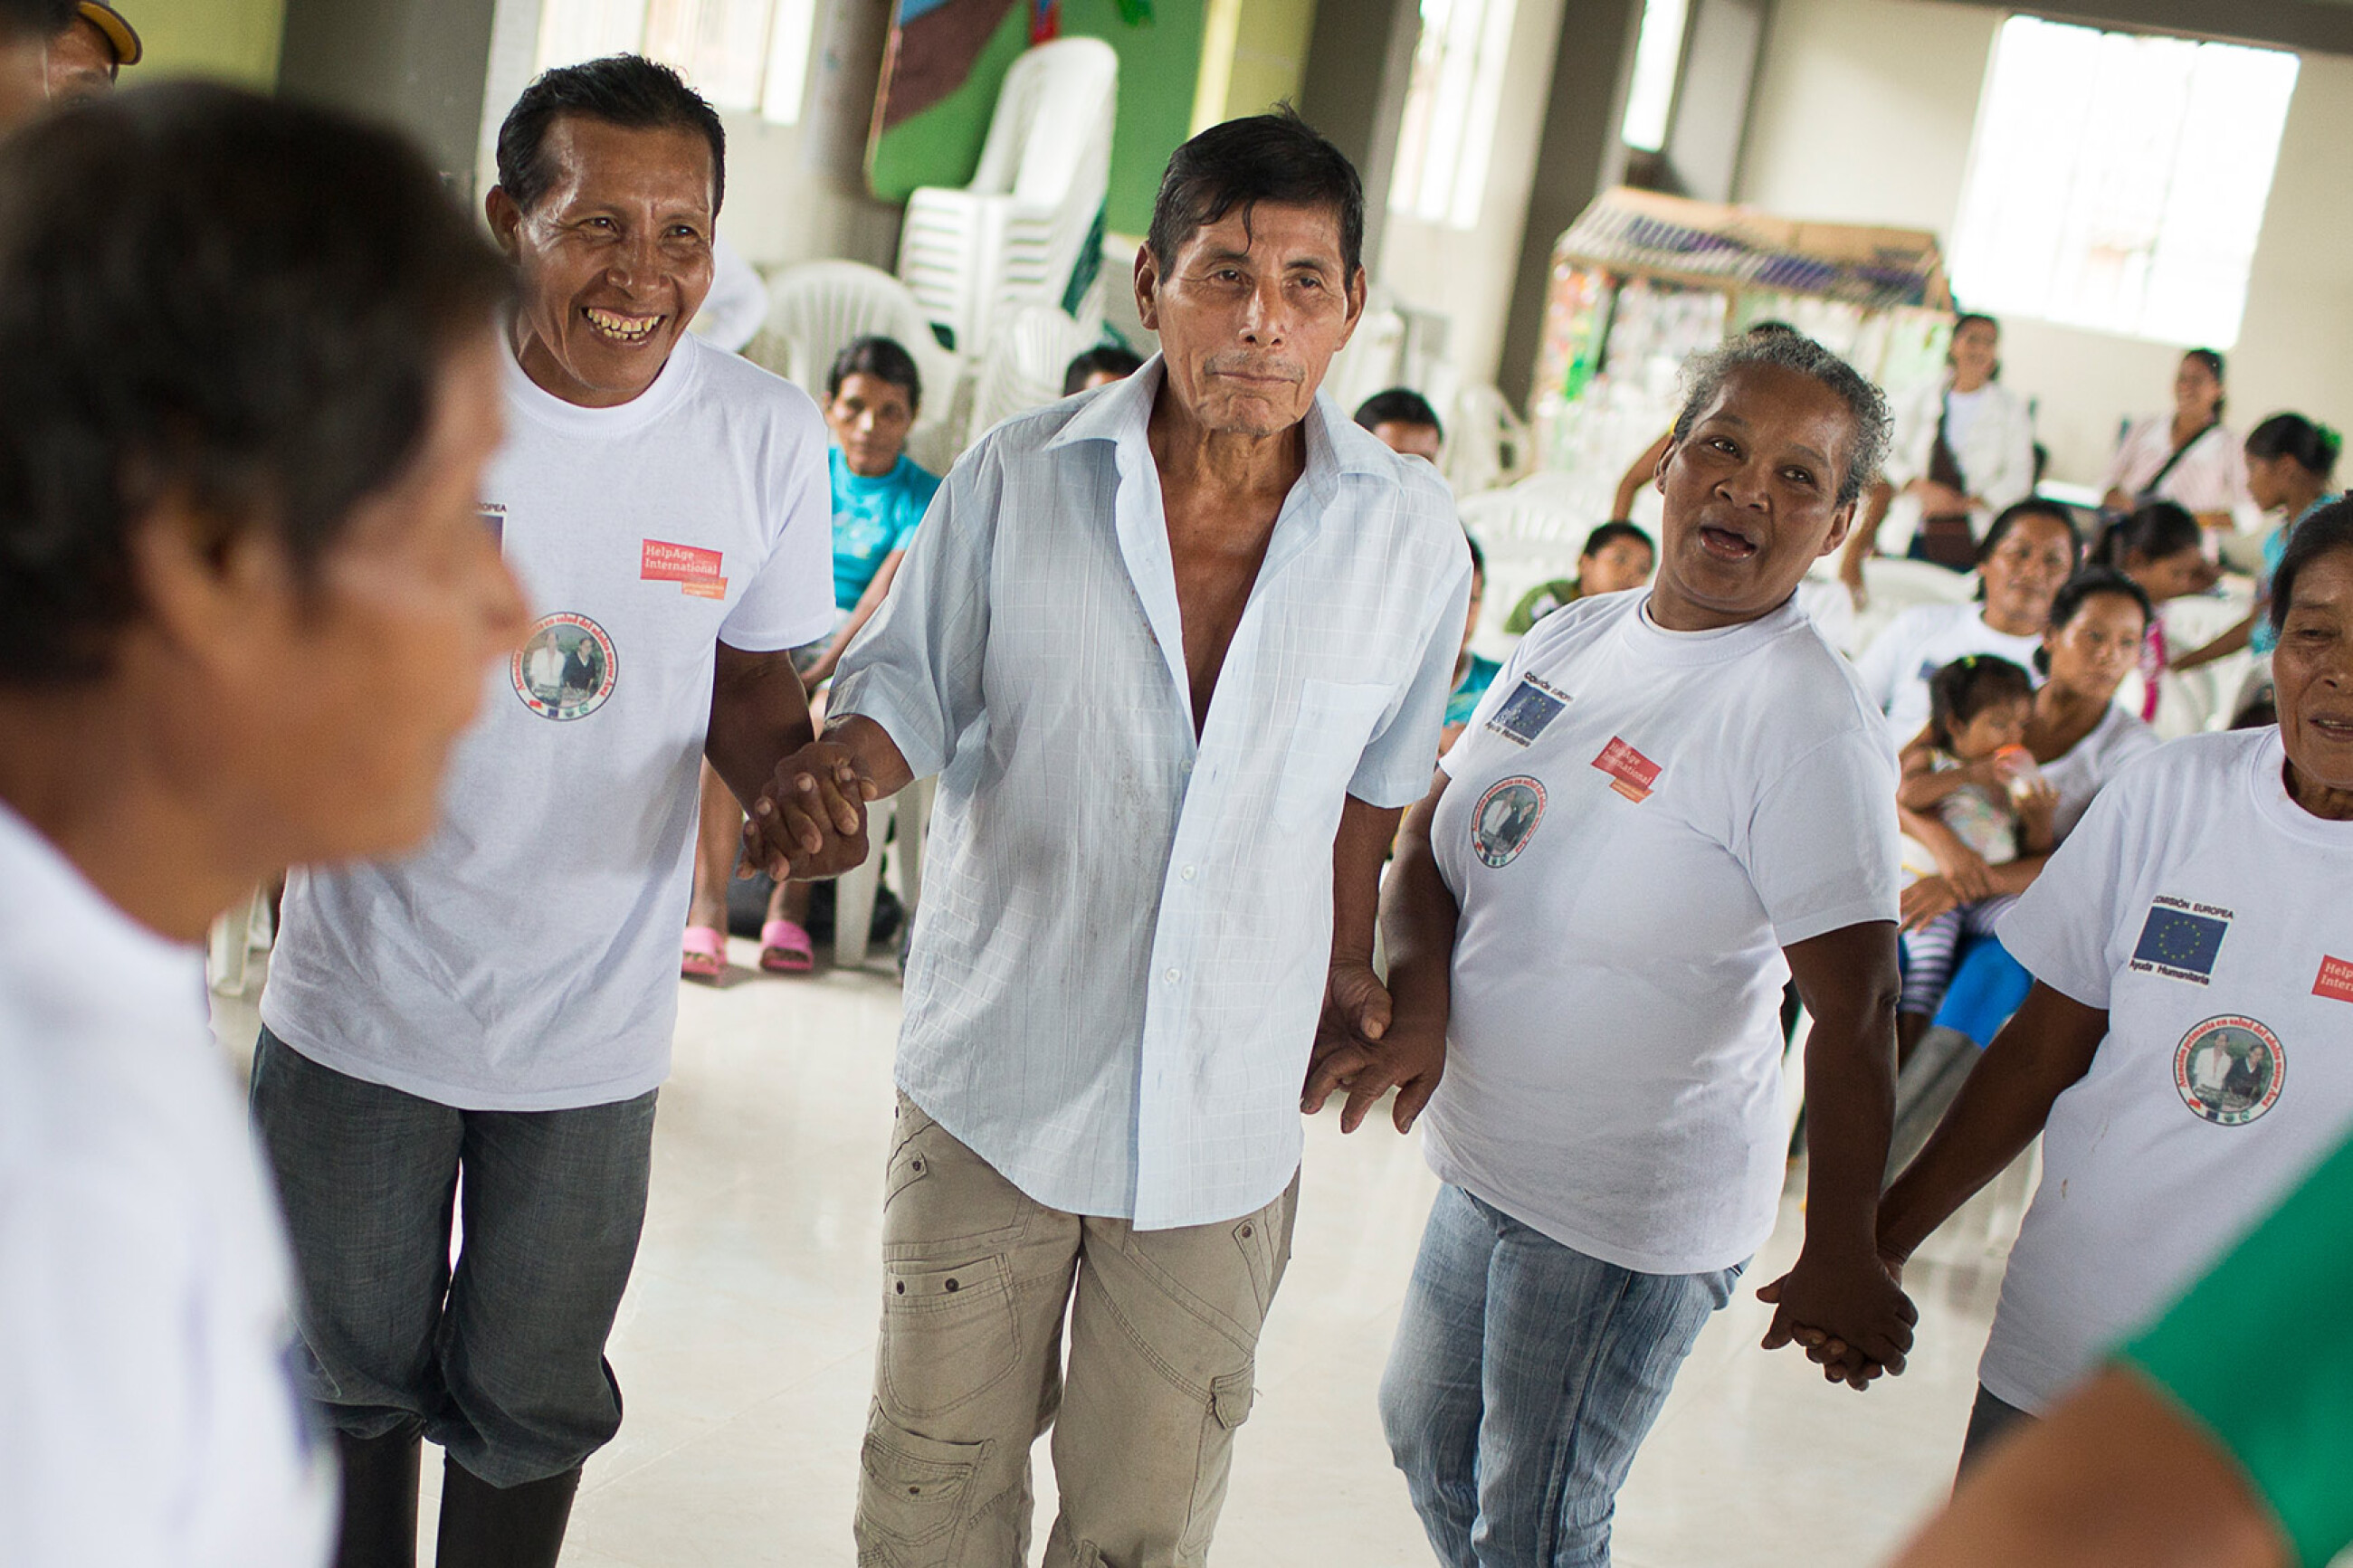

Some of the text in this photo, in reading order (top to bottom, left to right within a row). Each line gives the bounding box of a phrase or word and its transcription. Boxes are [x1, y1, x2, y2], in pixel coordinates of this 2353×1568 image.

[645, 545, 694, 561] HelpAge
[644, 558, 717, 575] International
[2194, 903, 2233, 919] EUROPEA
[2157, 965, 2210, 985] Humanitaria
[2229, 1017, 2254, 1030] salud
[2253, 1023, 2268, 1037] del
